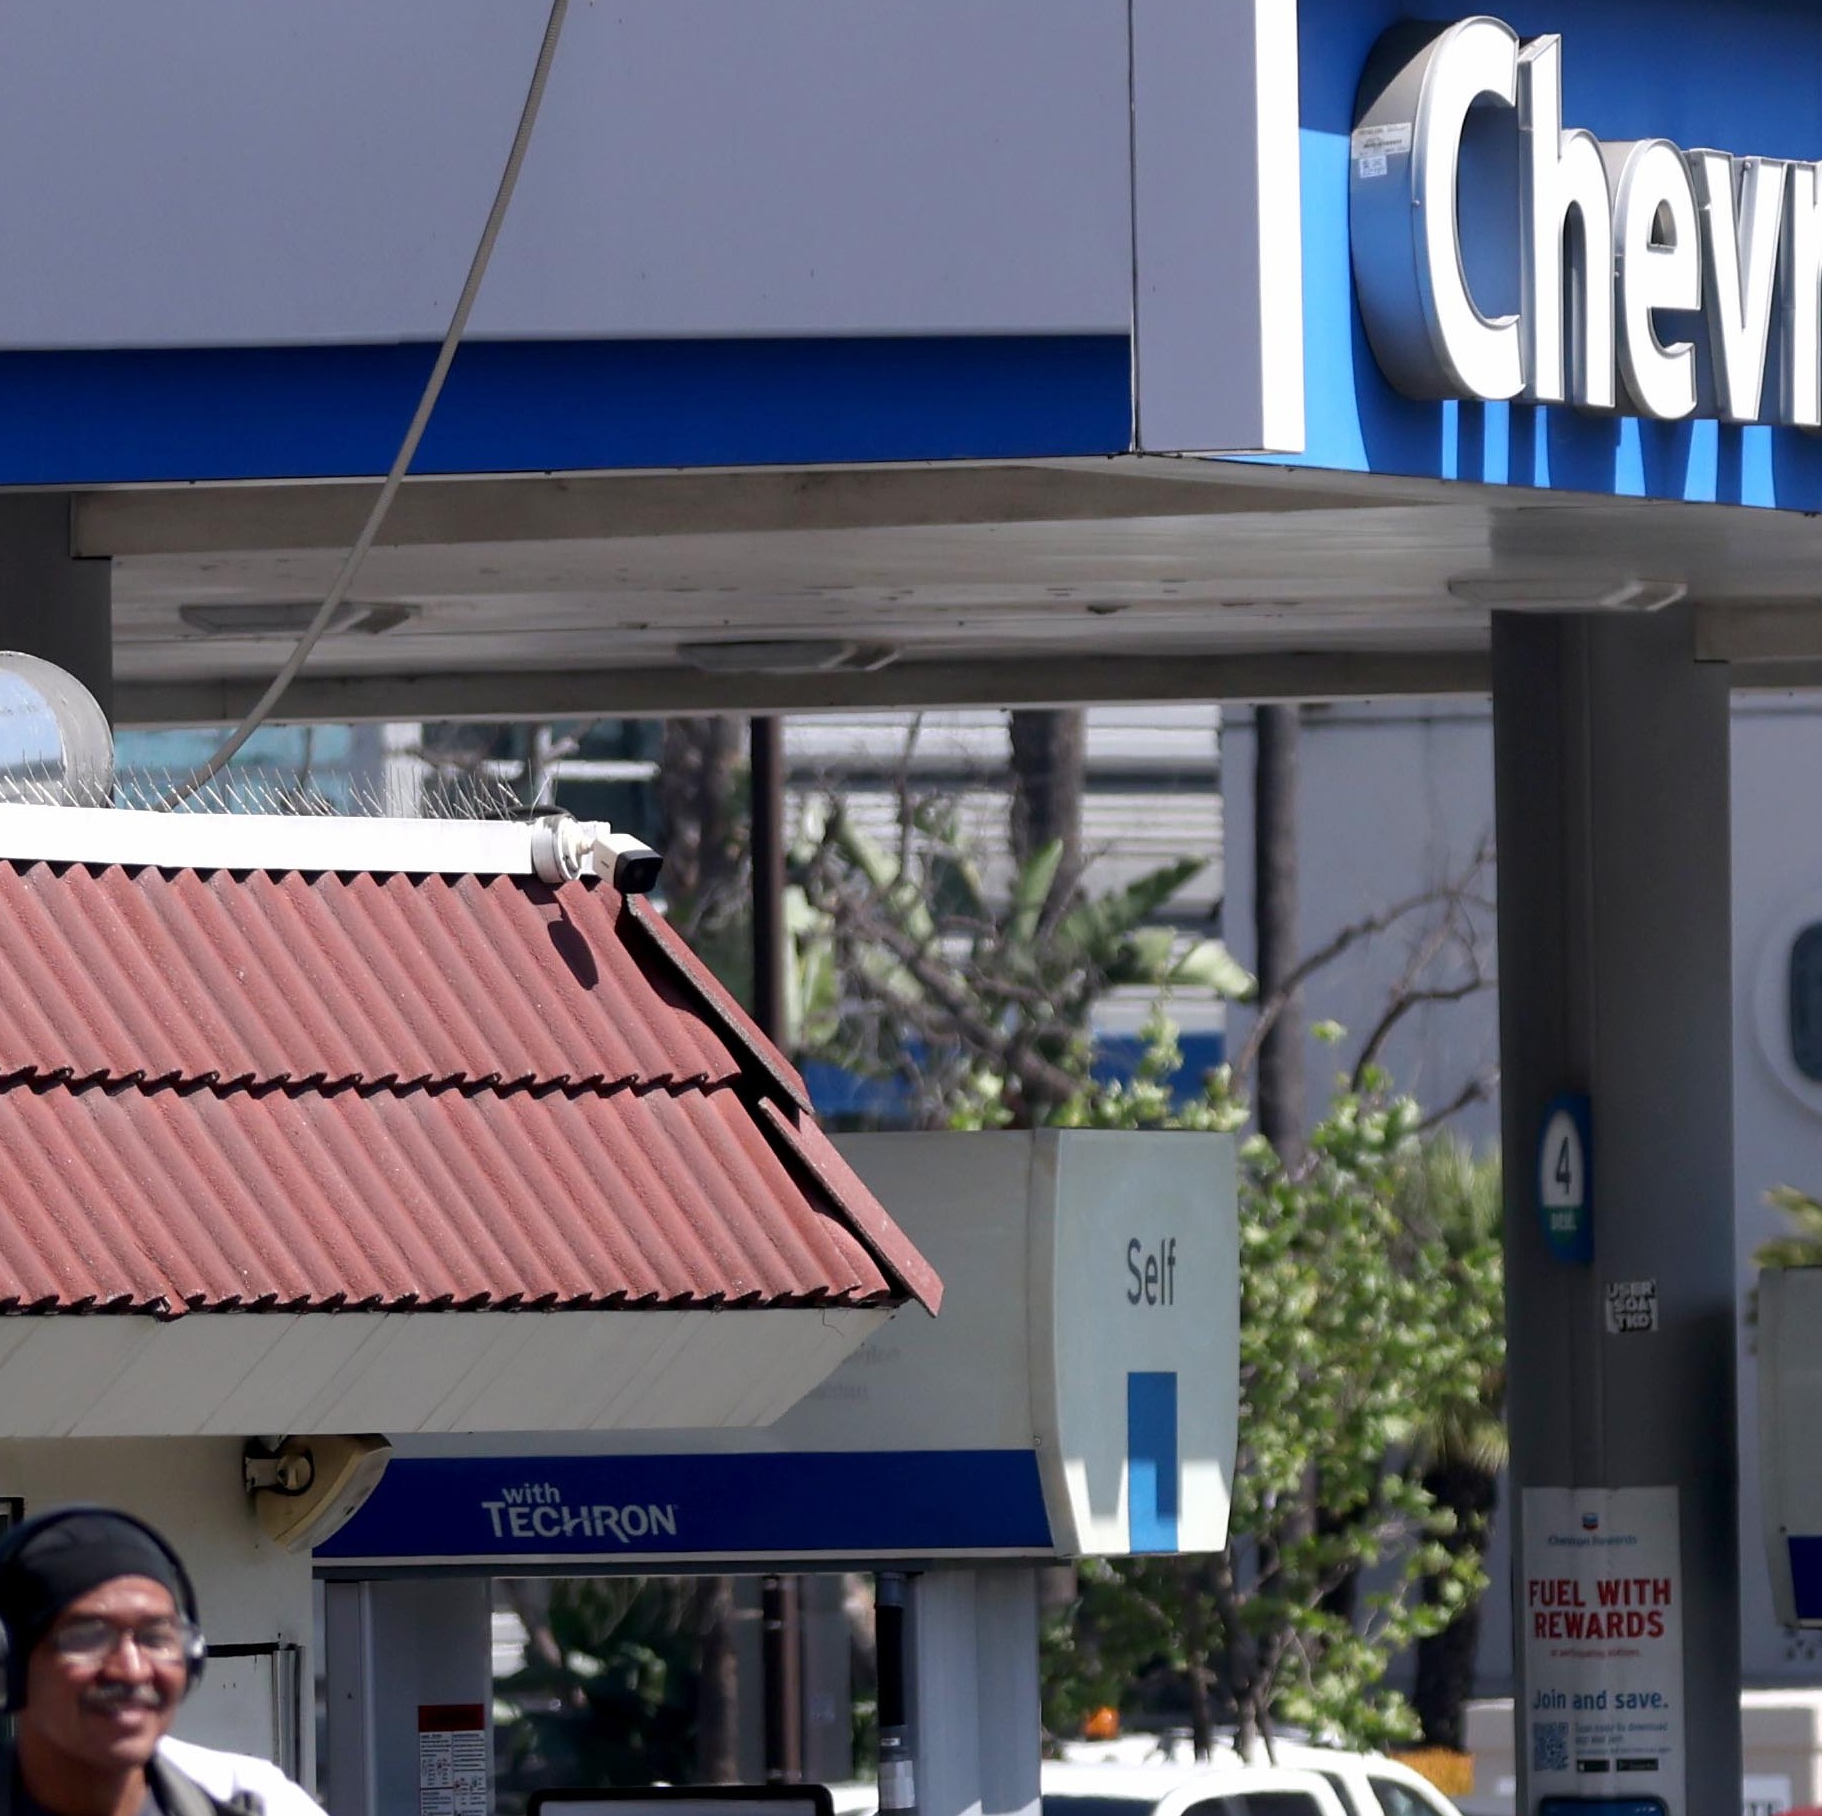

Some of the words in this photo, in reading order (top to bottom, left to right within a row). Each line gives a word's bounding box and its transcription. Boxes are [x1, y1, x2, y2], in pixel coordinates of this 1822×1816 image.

[1555, 1135, 1572, 1195] 4
[1127, 1237, 1177, 1309] Self
[502, 1482, 560, 1507] with
[481, 1499, 675, 1544] TECHRON
[1529, 1579, 1586, 1608] FUEL
[1597, 1577, 1672, 1606] WITH
[1534, 1610, 1665, 1640] REWARDS
[1533, 1688, 1567, 1710] Join
[1572, 1689, 1607, 1710] and
[1615, 1689, 1670, 1710] save.
